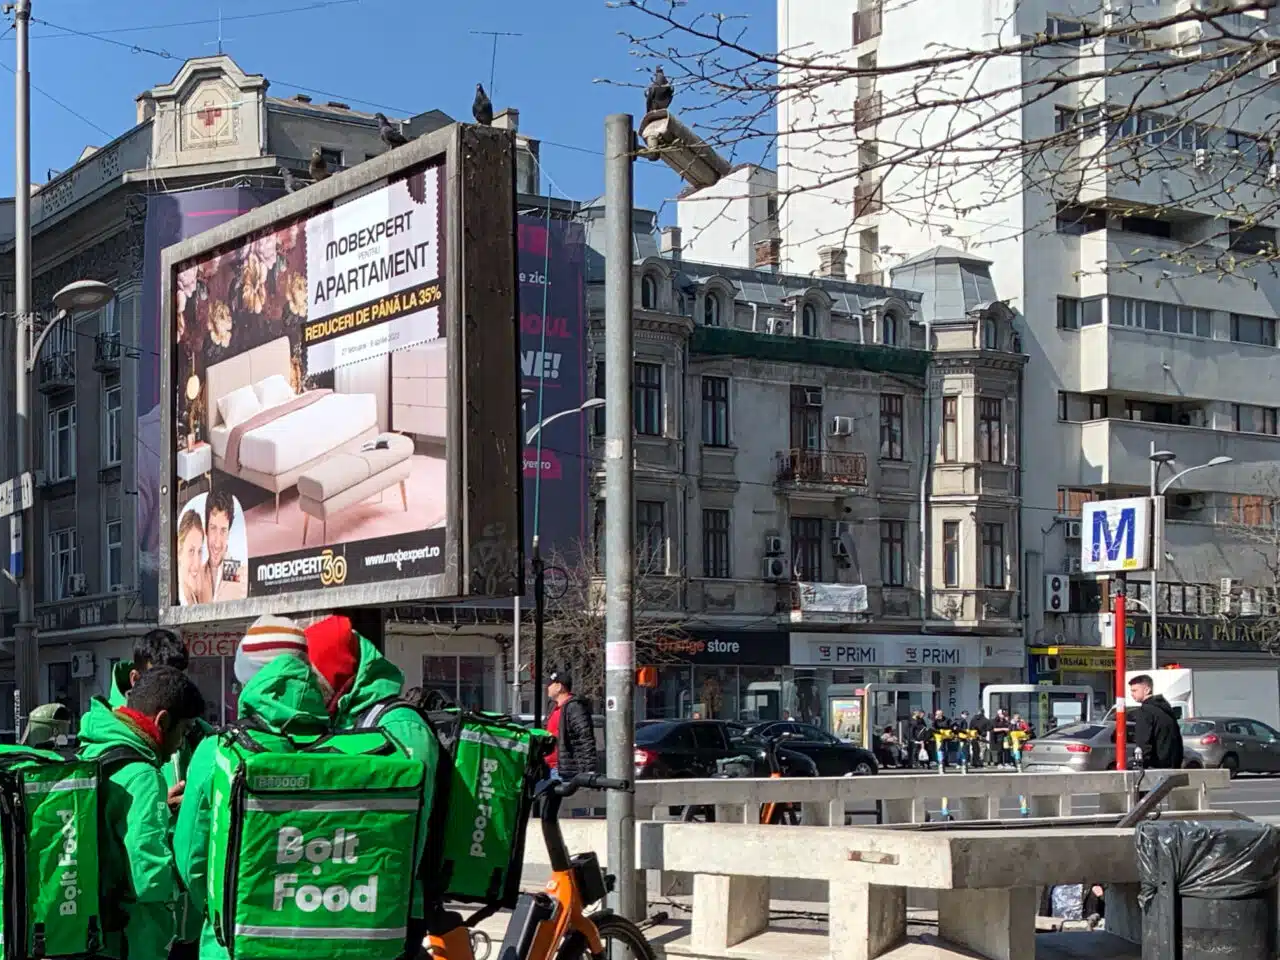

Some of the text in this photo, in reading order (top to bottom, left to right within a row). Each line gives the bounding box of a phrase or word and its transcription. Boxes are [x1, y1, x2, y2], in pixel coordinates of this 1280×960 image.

[326, 210, 414, 262] MOBEXPERT
[314, 241, 430, 305] APARTAMENT
[305, 315, 355, 342] REDUCERI
[355, 308, 370, 326] DE
[402, 294, 420, 310] LA
[418, 284, 442, 305] 35%
[364, 546, 440, 567] www.mobexpert.ro
[1091, 507, 1136, 562] M
[257, 555, 324, 582] MOBEXPERT
[320, 549, 348, 586] 30
[707, 638, 740, 654] store
[1142, 620, 1204, 641] DENTAL
[470, 757, 499, 858] Bolt Food
[56, 809, 82, 916] Bolt Food
[276, 826, 360, 865] Bolt
[272, 873, 379, 913] Food
